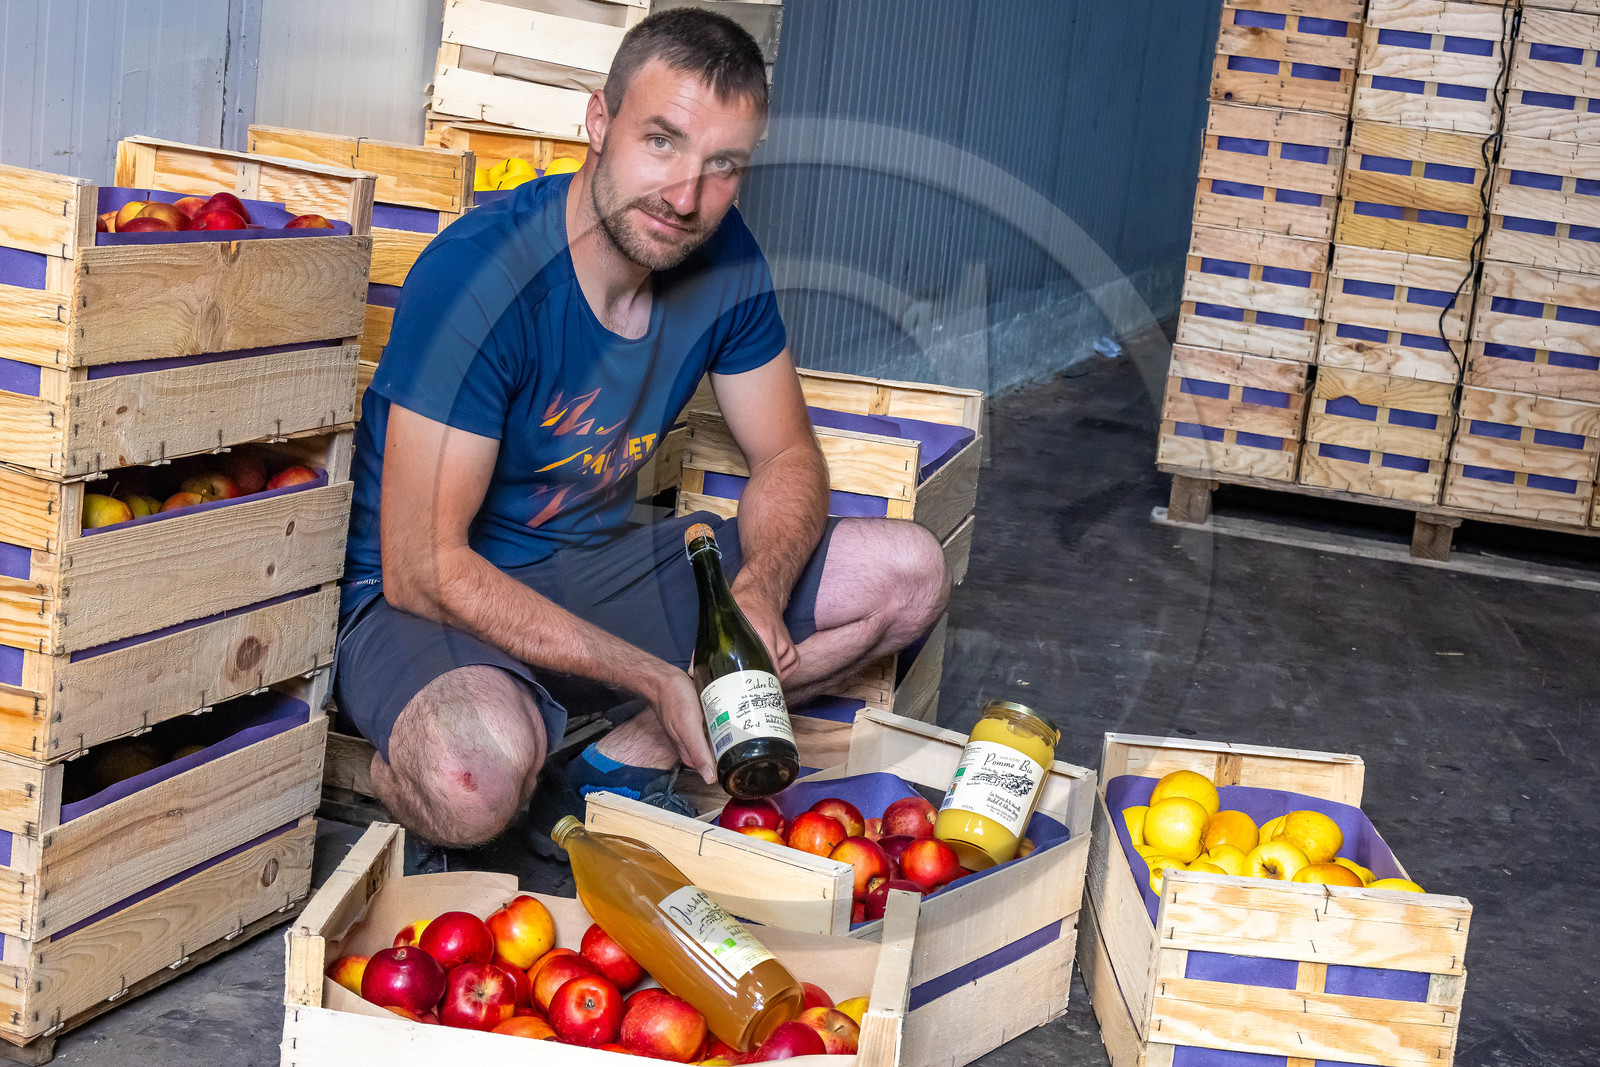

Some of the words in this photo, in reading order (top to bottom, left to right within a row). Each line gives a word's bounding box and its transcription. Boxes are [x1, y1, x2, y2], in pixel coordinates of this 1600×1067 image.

[745, 678, 767, 691] Cidre
[984, 753, 1015, 769] Pomme
[1019, 760, 1033, 774] Bio
[669, 903, 697, 926] Jus
